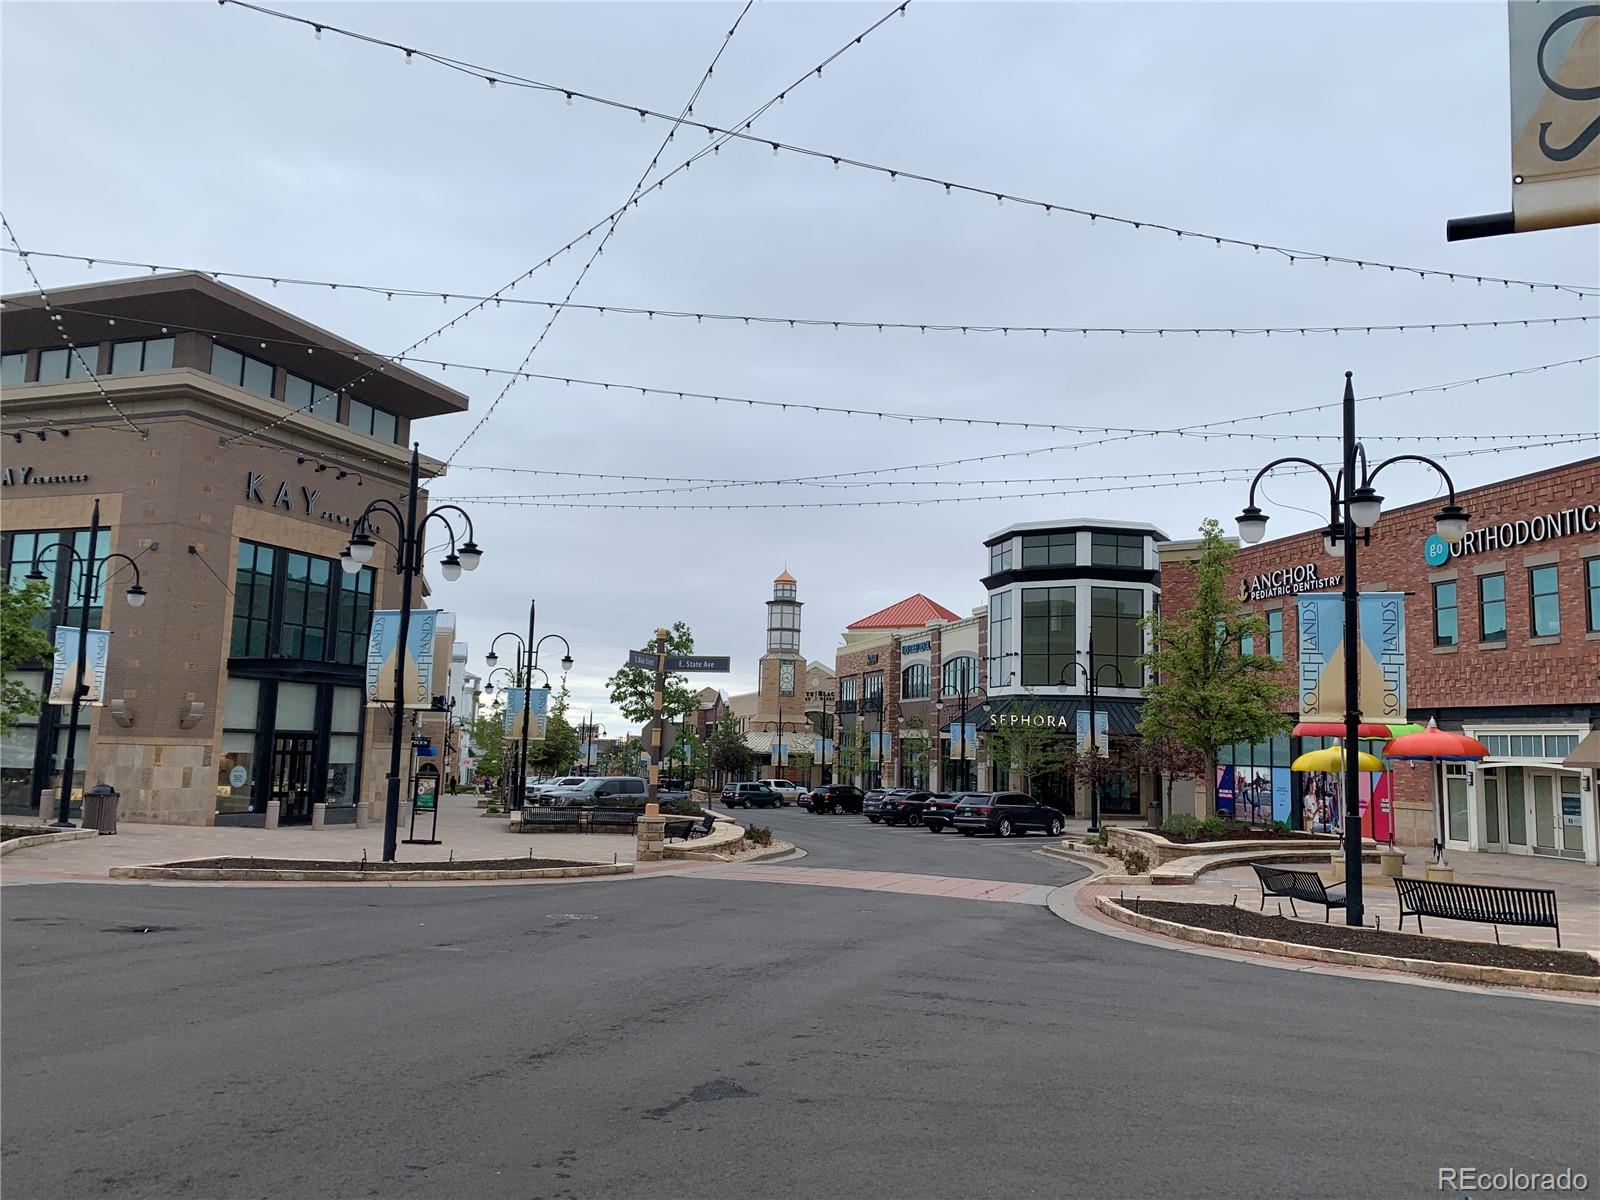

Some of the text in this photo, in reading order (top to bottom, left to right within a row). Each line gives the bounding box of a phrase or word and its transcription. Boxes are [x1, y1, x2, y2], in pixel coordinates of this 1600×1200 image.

[246, 471, 321, 515] KAY
[1429, 504, 1600, 558] go ORTHODONTIC
[1251, 563, 1317, 592] ANCHOR
[1251, 575, 1341, 600] PEDIATRIC DENTISTRY
[417, 615, 433, 702] SOUTHLANDS
[1302, 601, 1324, 714] SOUTHLANDS
[1381, 601, 1404, 716] SOUTHLANDS
[990, 714, 1068, 728] SEPHORA
